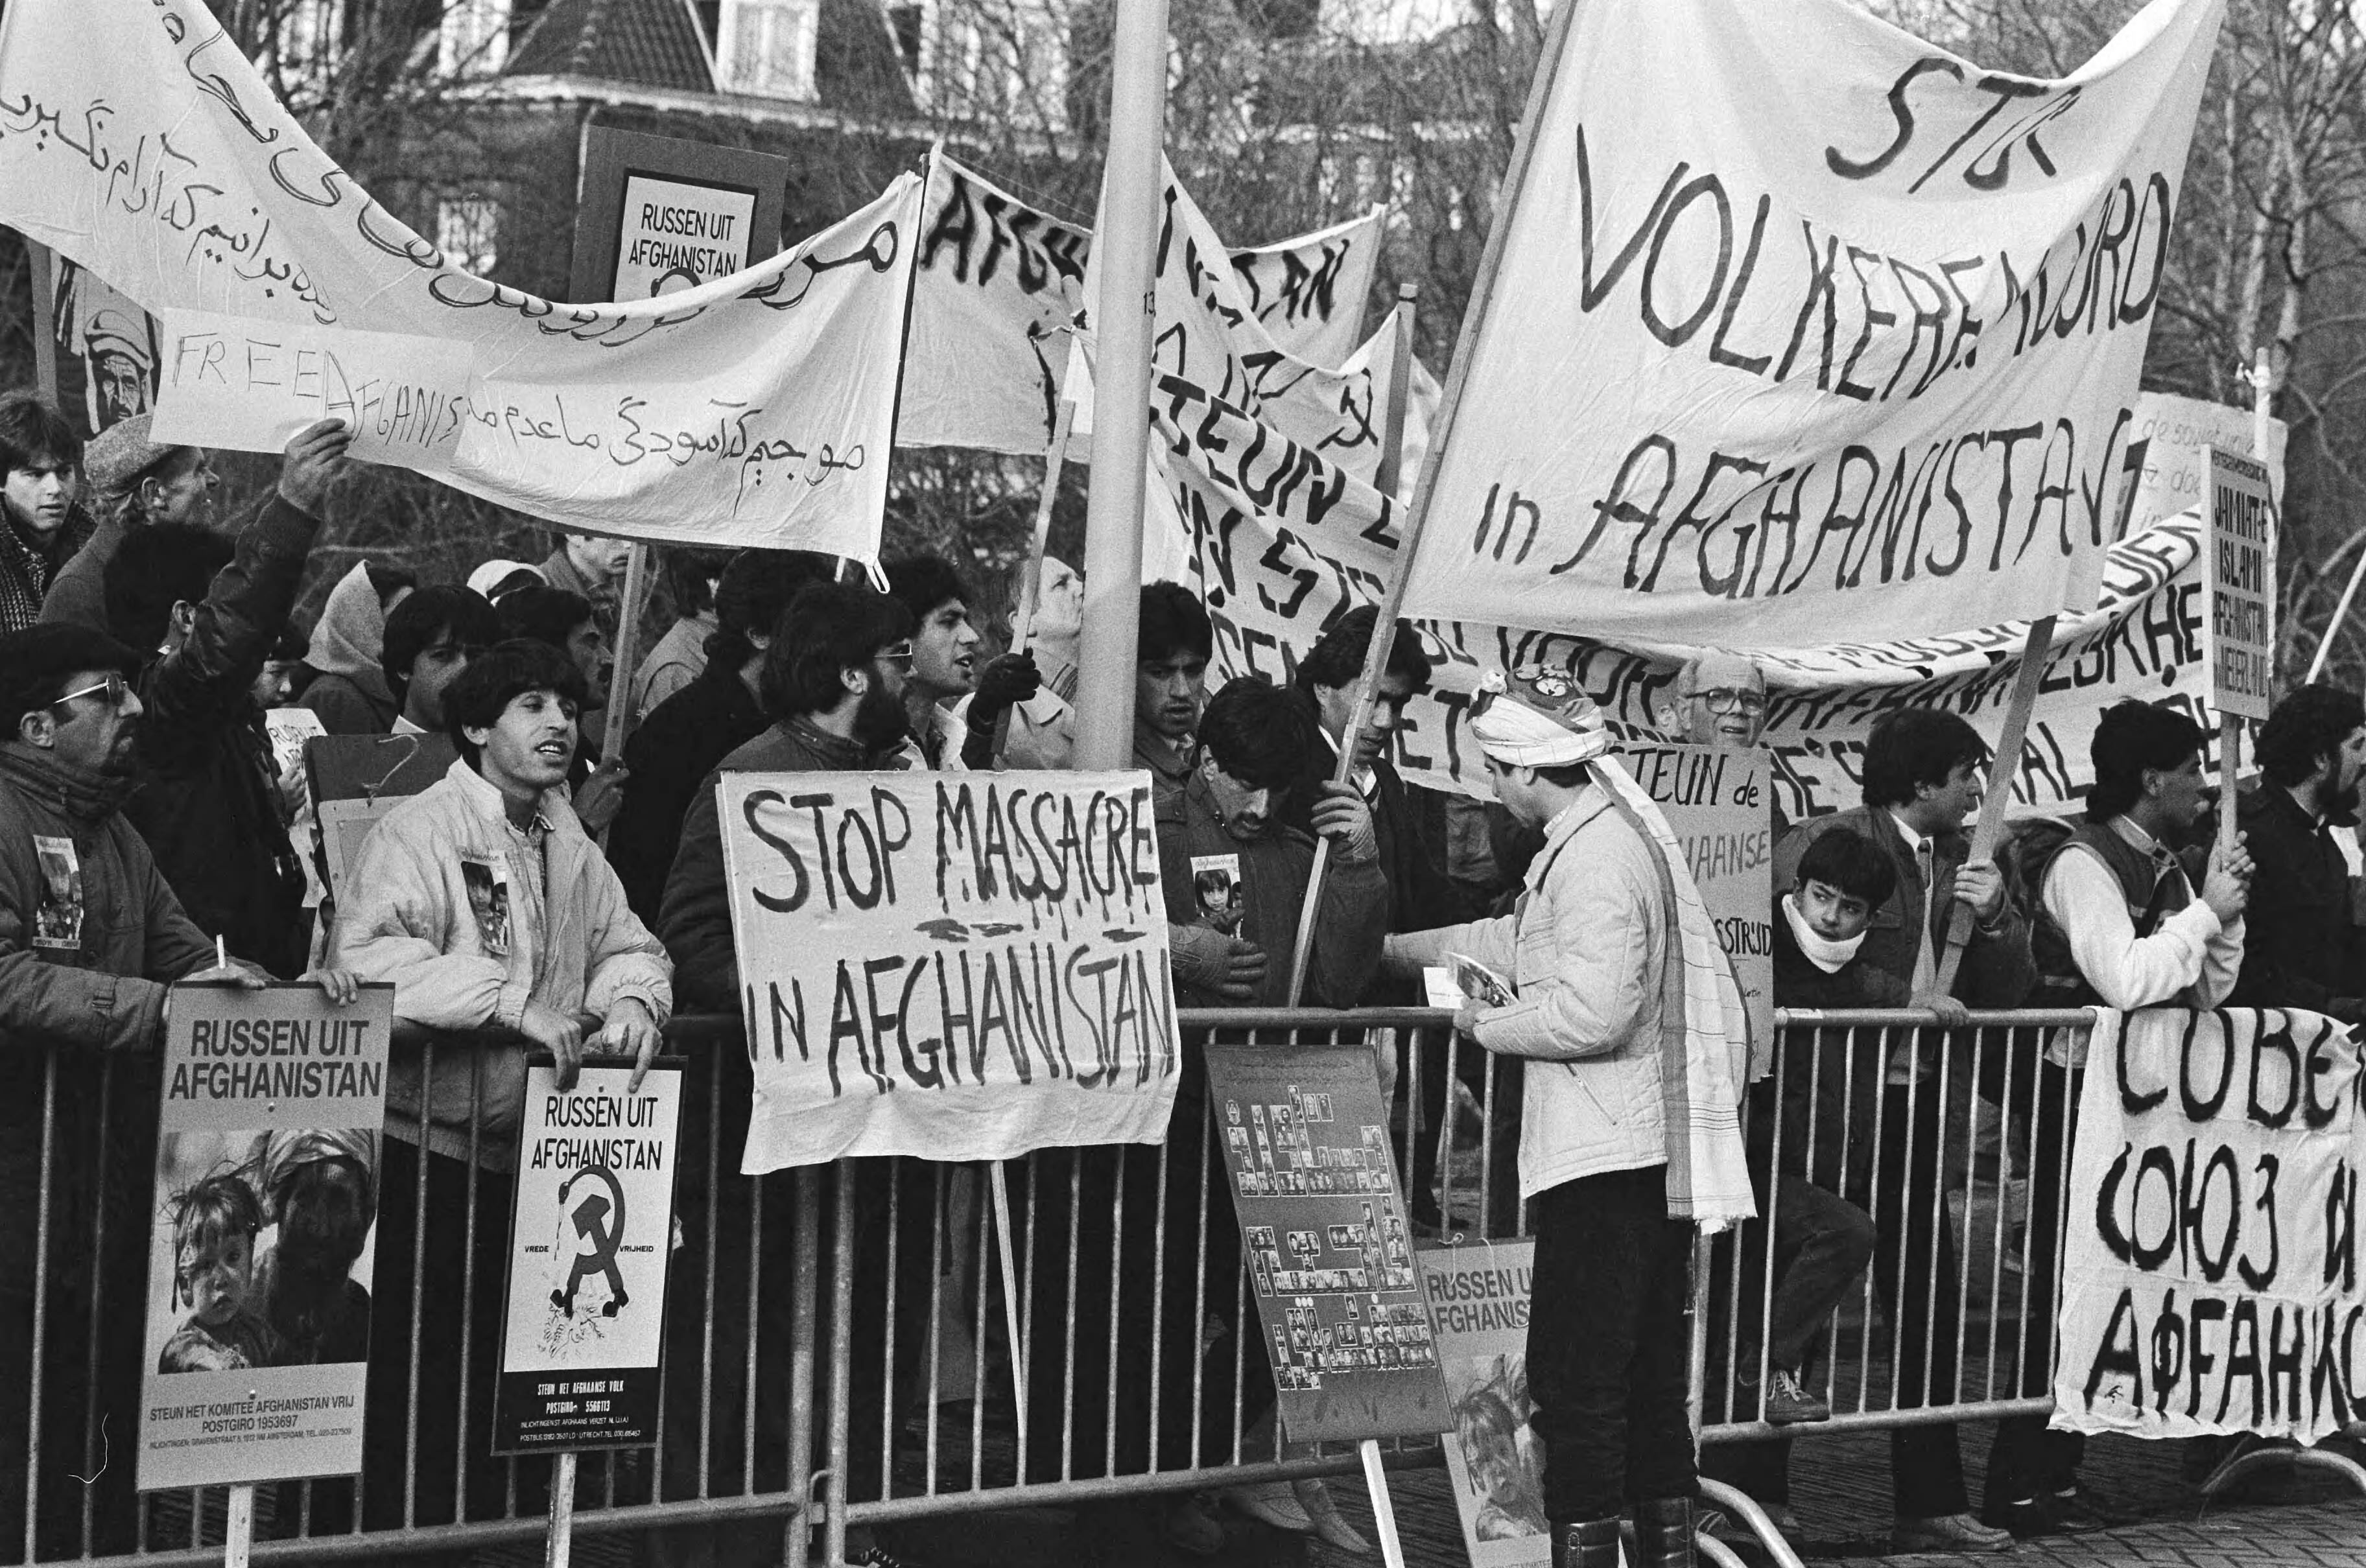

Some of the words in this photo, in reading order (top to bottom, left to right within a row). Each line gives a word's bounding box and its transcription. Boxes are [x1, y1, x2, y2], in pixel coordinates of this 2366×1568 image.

[641, 203, 707, 237] RUSSEN
[710, 213, 735, 241] UIT
[628, 238, 737, 277] AFGHANISTAN
[173, 332, 320, 397] FREE
[1149, 371, 1347, 526] TEUN
[2219, 537, 2262, 594] ISLAMI
[1609, 746, 1728, 806] TEUN
[1733, 769, 1759, 808] de
[742, 784, 912, 913] STOP
[936, 780, 1160, 915] MASSACRE
[1678, 830, 1770, 883] HAANSE
[190, 1020, 312, 1057] RUSSEN
[319, 1019, 369, 1055] UIT
[747, 976, 809, 1063] IN
[827, 942, 1175, 1099] AFGHANISTAN
[169, 1061, 381, 1100] AFGHANISTAN
[545, 1095, 621, 1129] RUSSEN
[627, 1096, 659, 1129] UIT
[531, 1138, 663, 1171] AFGHANISTAN
[2096, 1138, 2279, 1293] СОЮЗ
[619, 1245, 654, 1253] VRIJHEID
[1427, 1269, 1515, 1303] RUSSEN
[1427, 1300, 1530, 1335] FGHANIS
[537, 1383, 556, 1396] STEUN
[559, 1383, 570, 1394] HET
[573, 1381, 606, 1394] AFGHAANSE
[609, 1380, 624, 1393] VOLK
[150, 1405, 183, 1422] STEUN
[185, 1404, 207, 1418] HET
[208, 1401, 254, 1417] KOMITEE
[256, 1396, 329, 1413] AFGHANISTAN
[332, 1395, 355, 1409] VRIJ
[202, 1418, 255, 1434] POSTGIRO
[257, 1414, 298, 1430] 1953697
